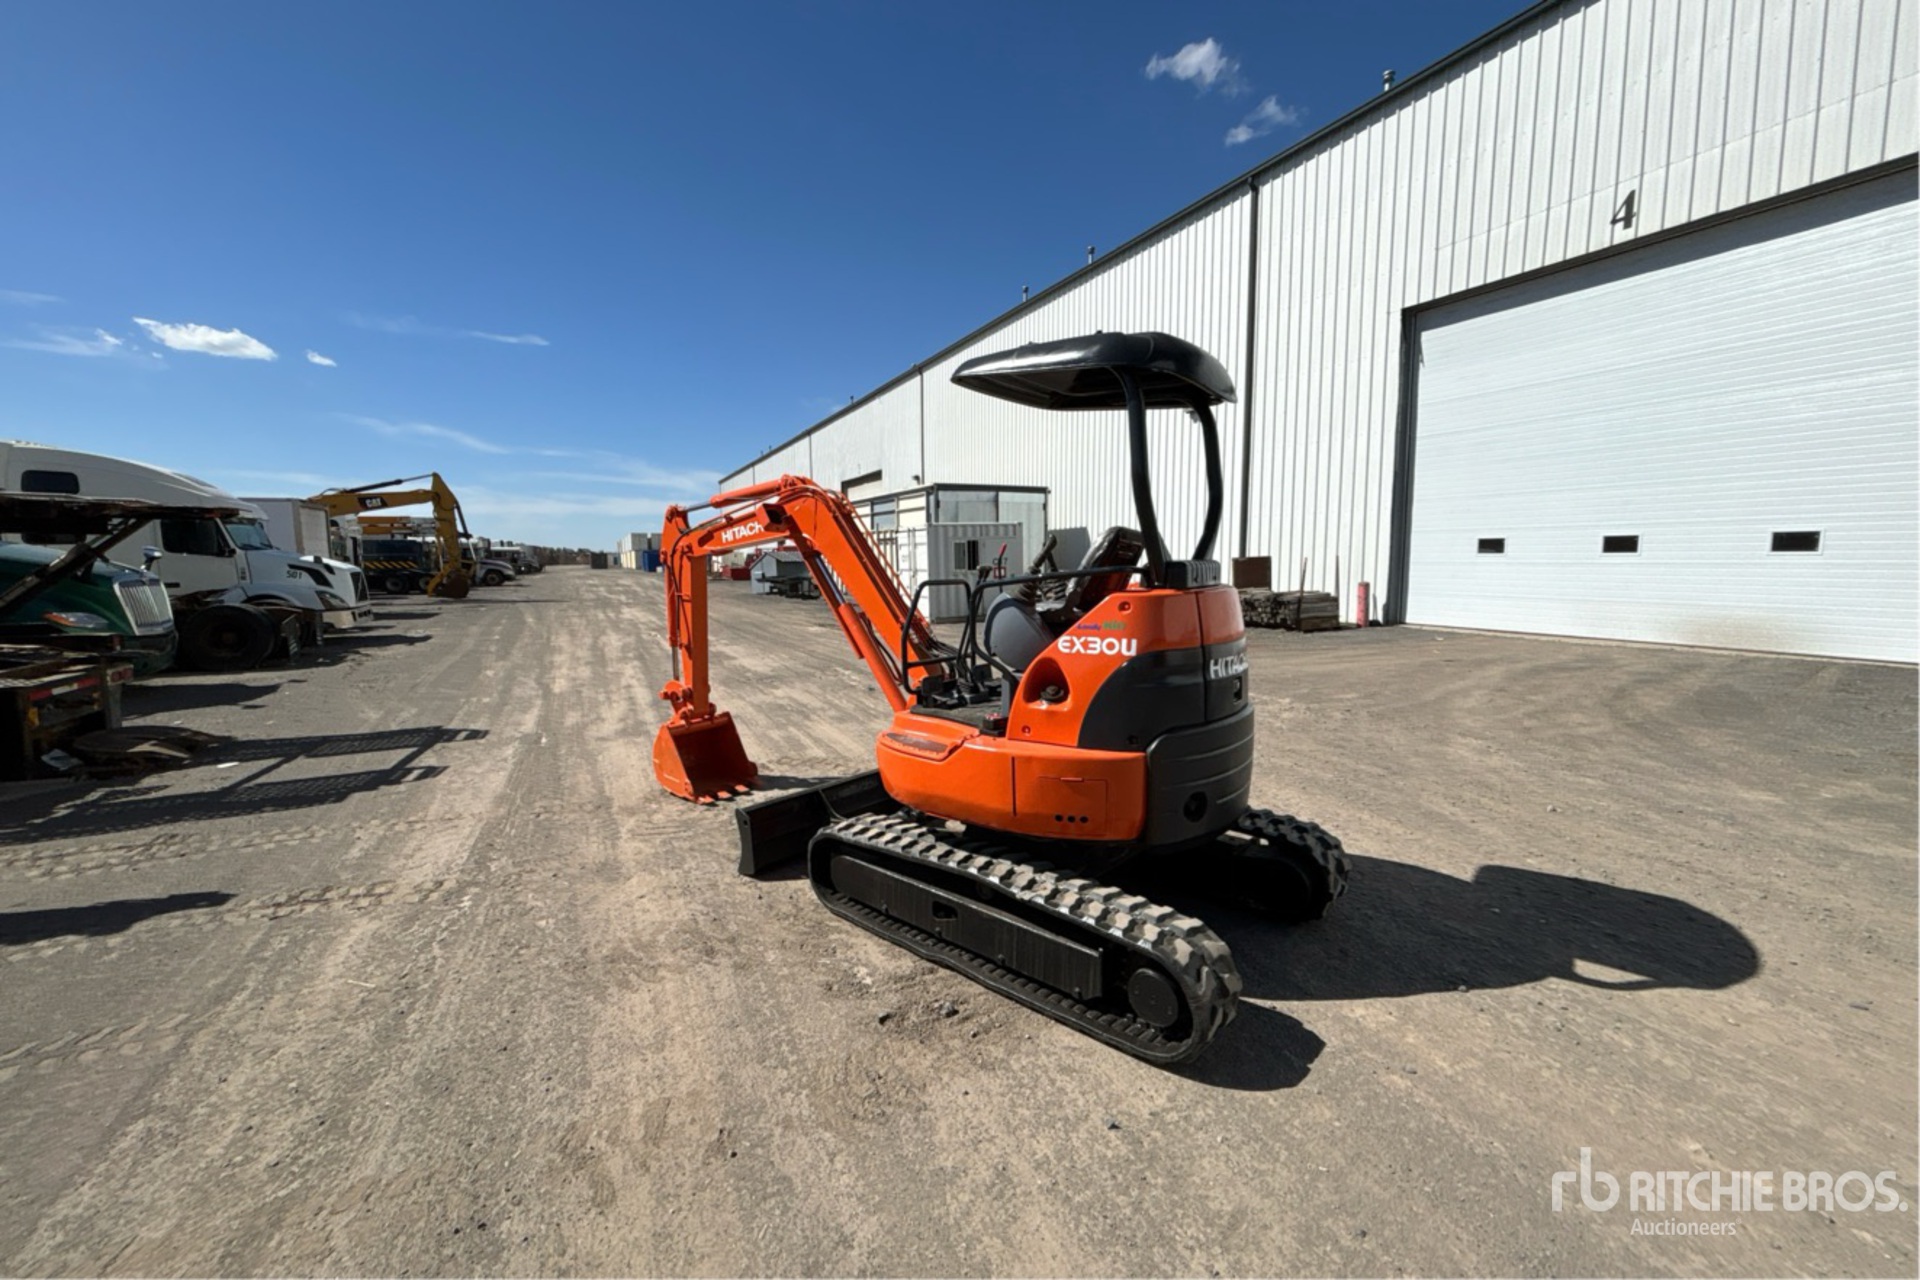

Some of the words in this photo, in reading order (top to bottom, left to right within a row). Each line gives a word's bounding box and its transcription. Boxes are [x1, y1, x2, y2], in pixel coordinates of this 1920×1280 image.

[1610, 189, 1636, 230] 4
[365, 497, 382, 508] CAT
[721, 521, 765, 544] HITACH
[1057, 635, 1137, 657] EX30U
